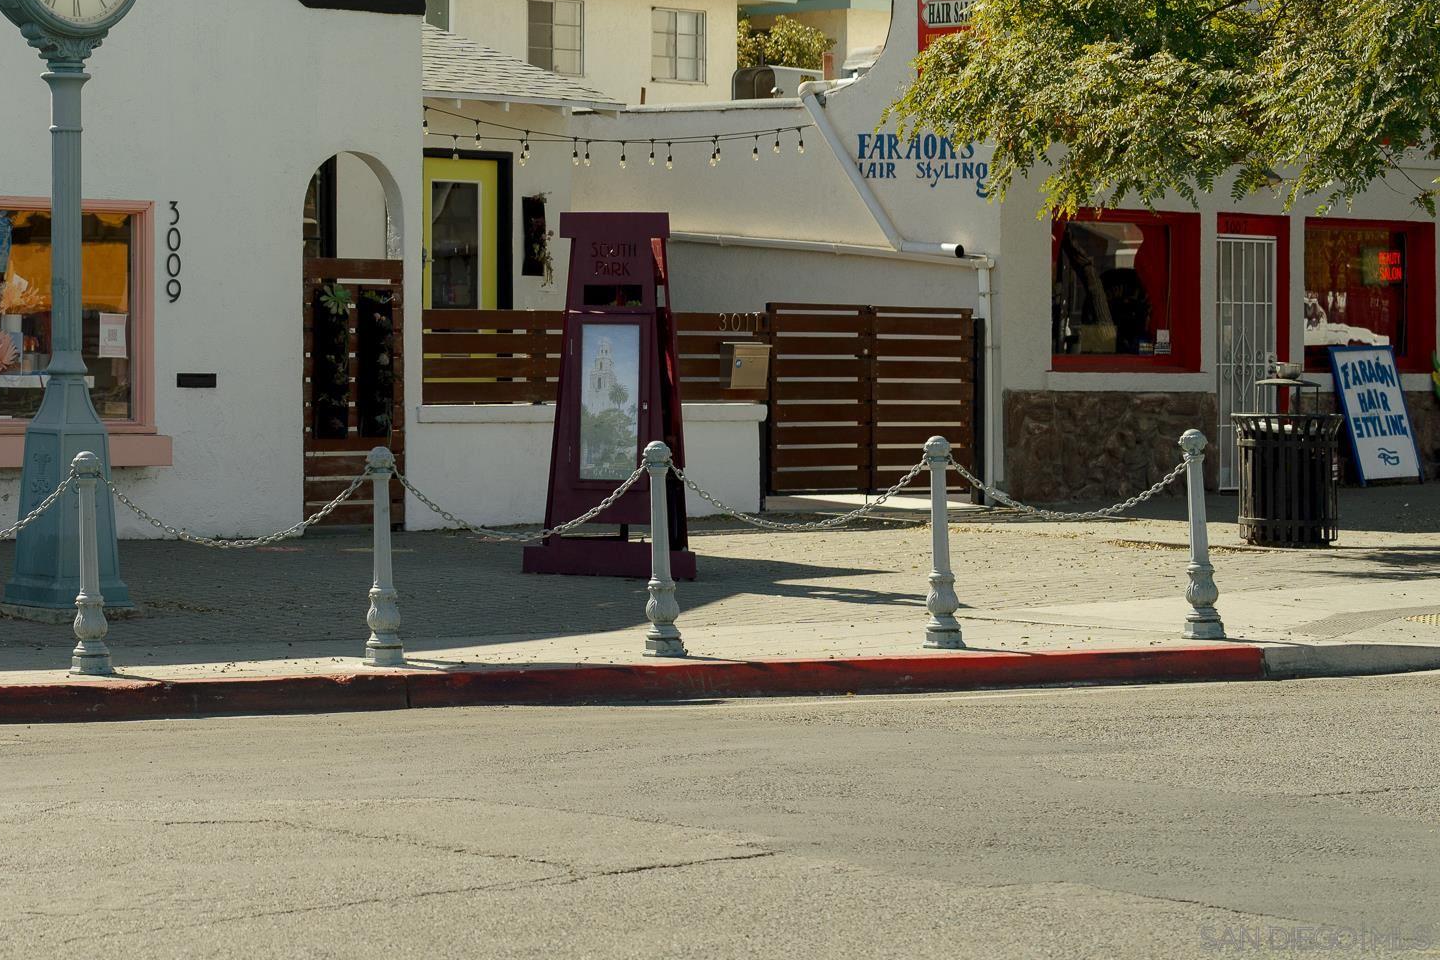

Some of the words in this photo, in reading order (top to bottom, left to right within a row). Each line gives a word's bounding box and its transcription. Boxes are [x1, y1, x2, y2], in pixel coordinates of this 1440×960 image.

[928, 2, 951, 24] HAIR
[167, 201, 182, 304] 3009
[591, 241, 637, 257] SOUTH
[1378, 251, 1401, 264] BEAUTY
[595, 260, 631, 276] PARK
[1379, 267, 1402, 281] SALON
[719, 312, 760, 332] 3011
[1357, 389, 1391, 413] HAIR
[1353, 414, 1409, 438] STYLING
